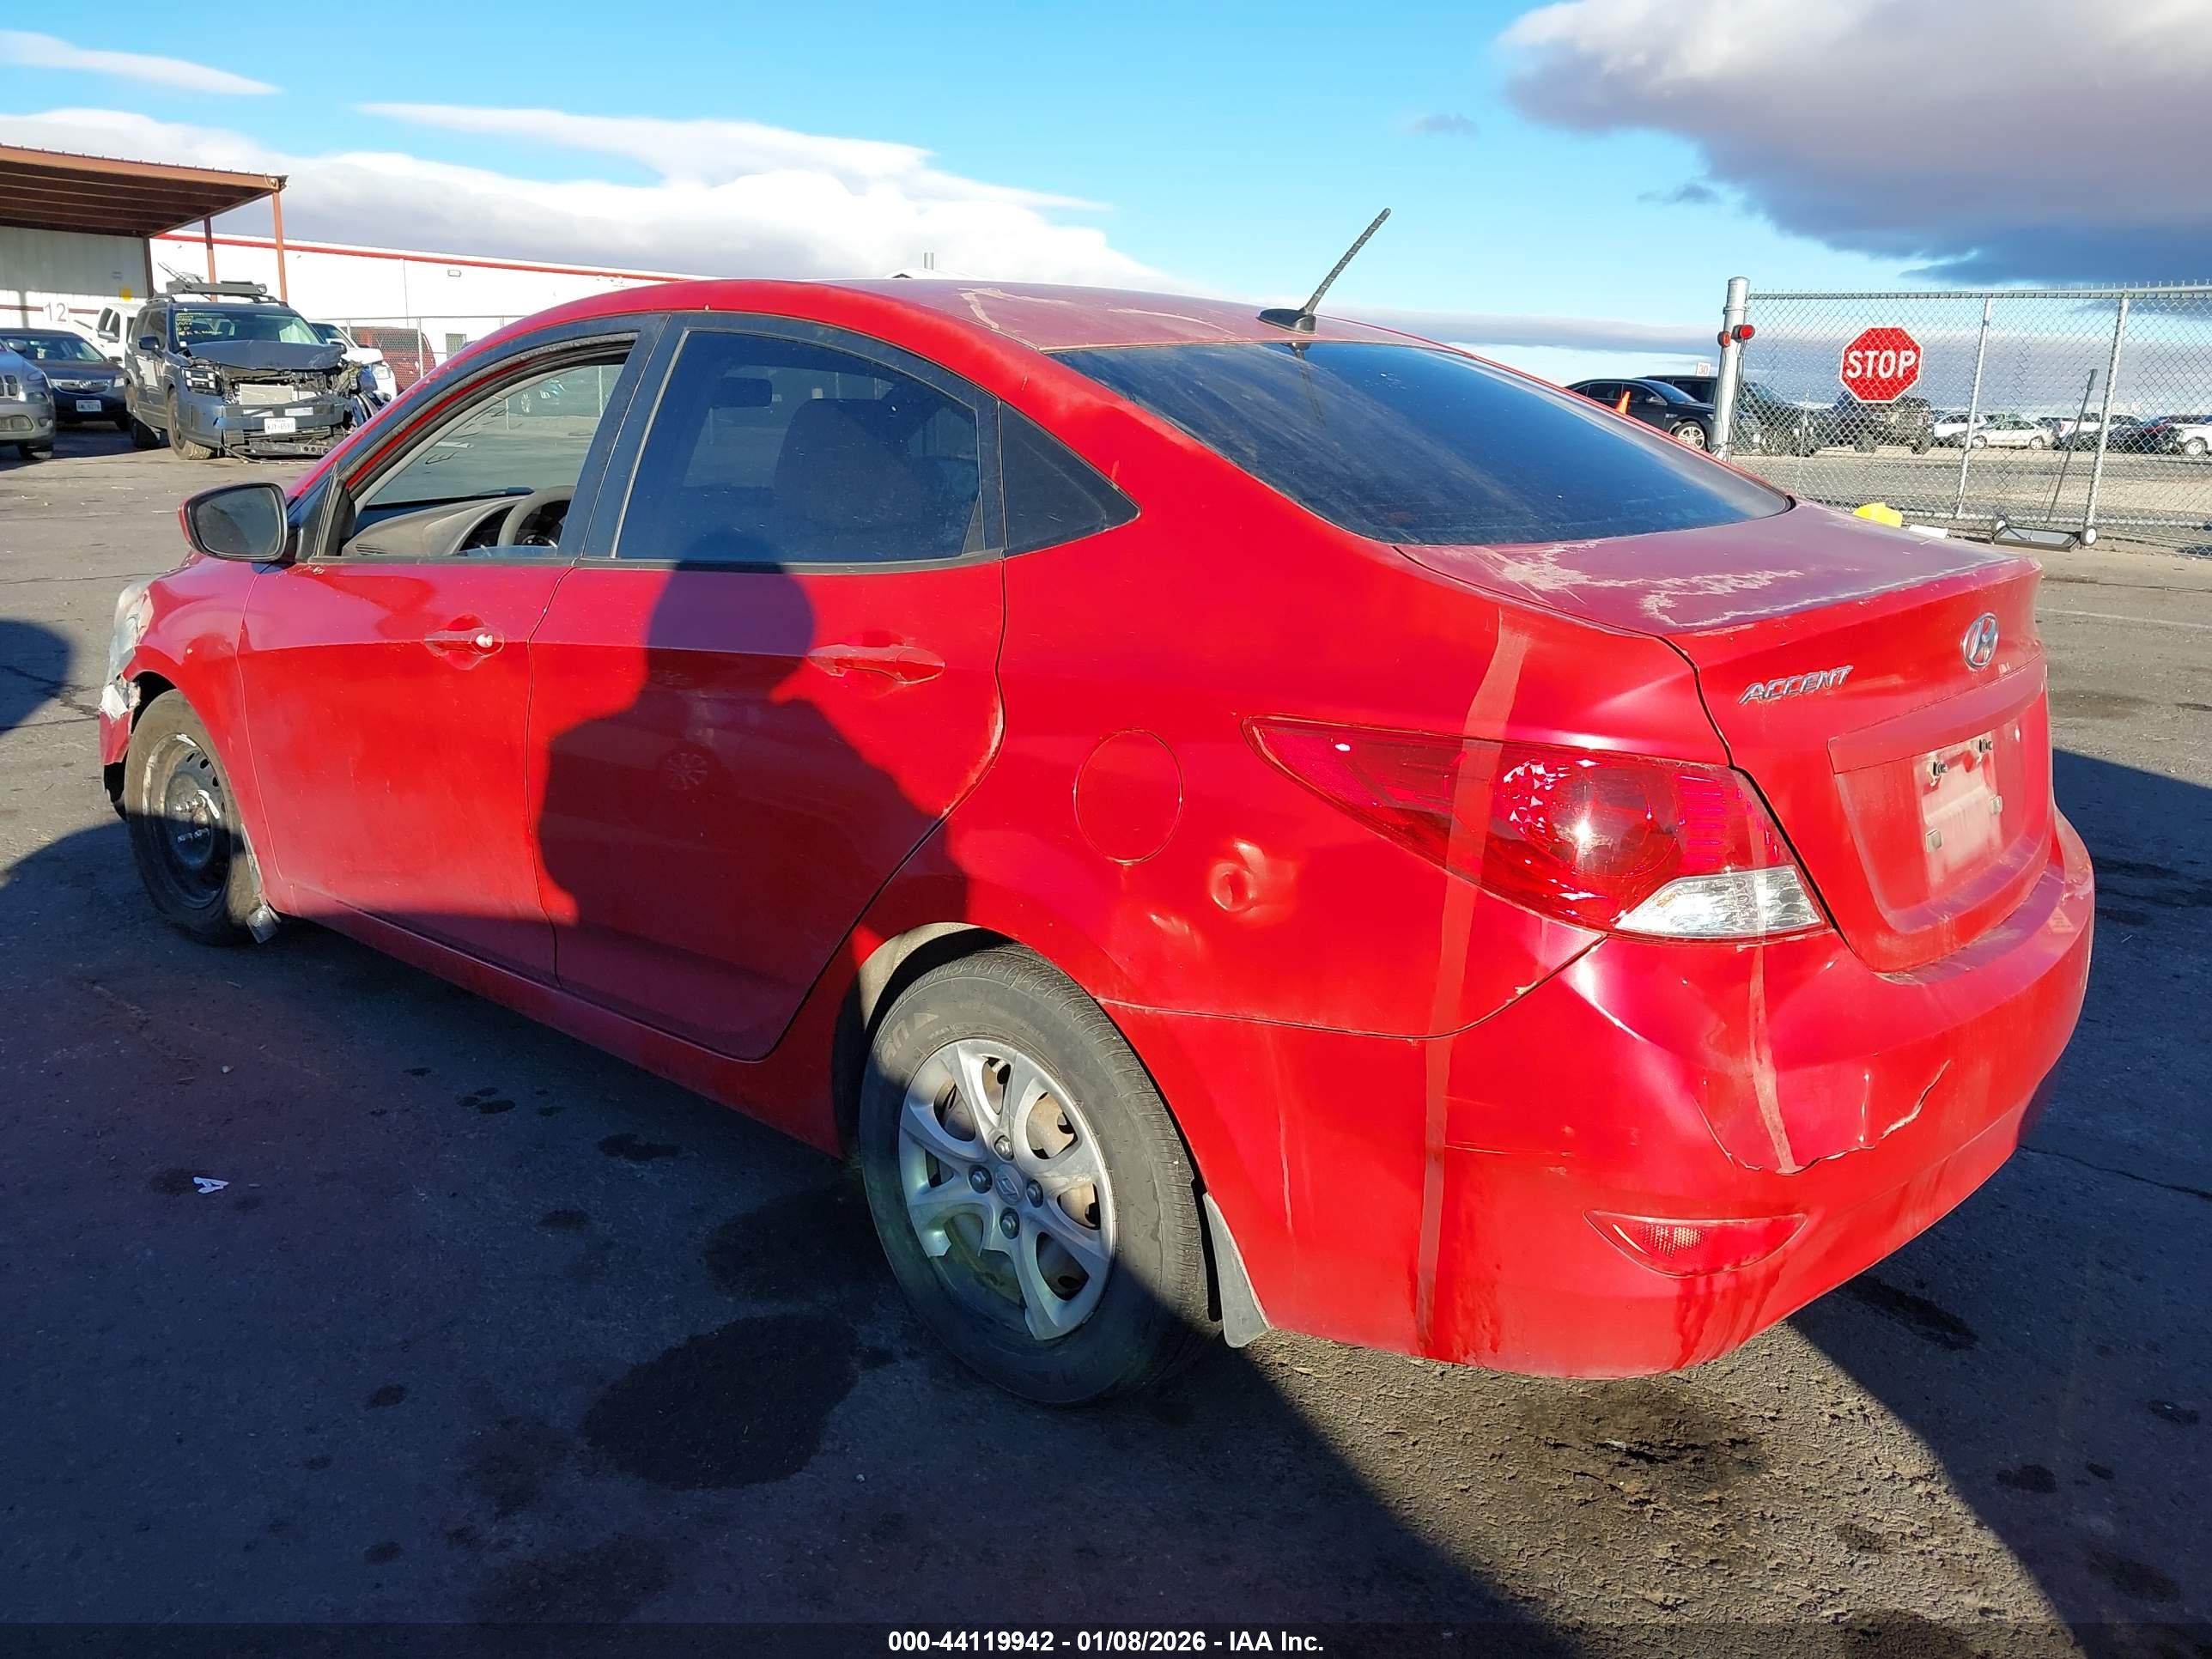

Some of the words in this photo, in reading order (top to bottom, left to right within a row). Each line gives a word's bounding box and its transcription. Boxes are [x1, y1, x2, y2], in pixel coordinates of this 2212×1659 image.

[45, 301, 67, 322] 12
[1698, 364, 1709, 374] 30
[1846, 349, 1917, 379] STOP
[1739, 665, 1854, 704] ACCENT
